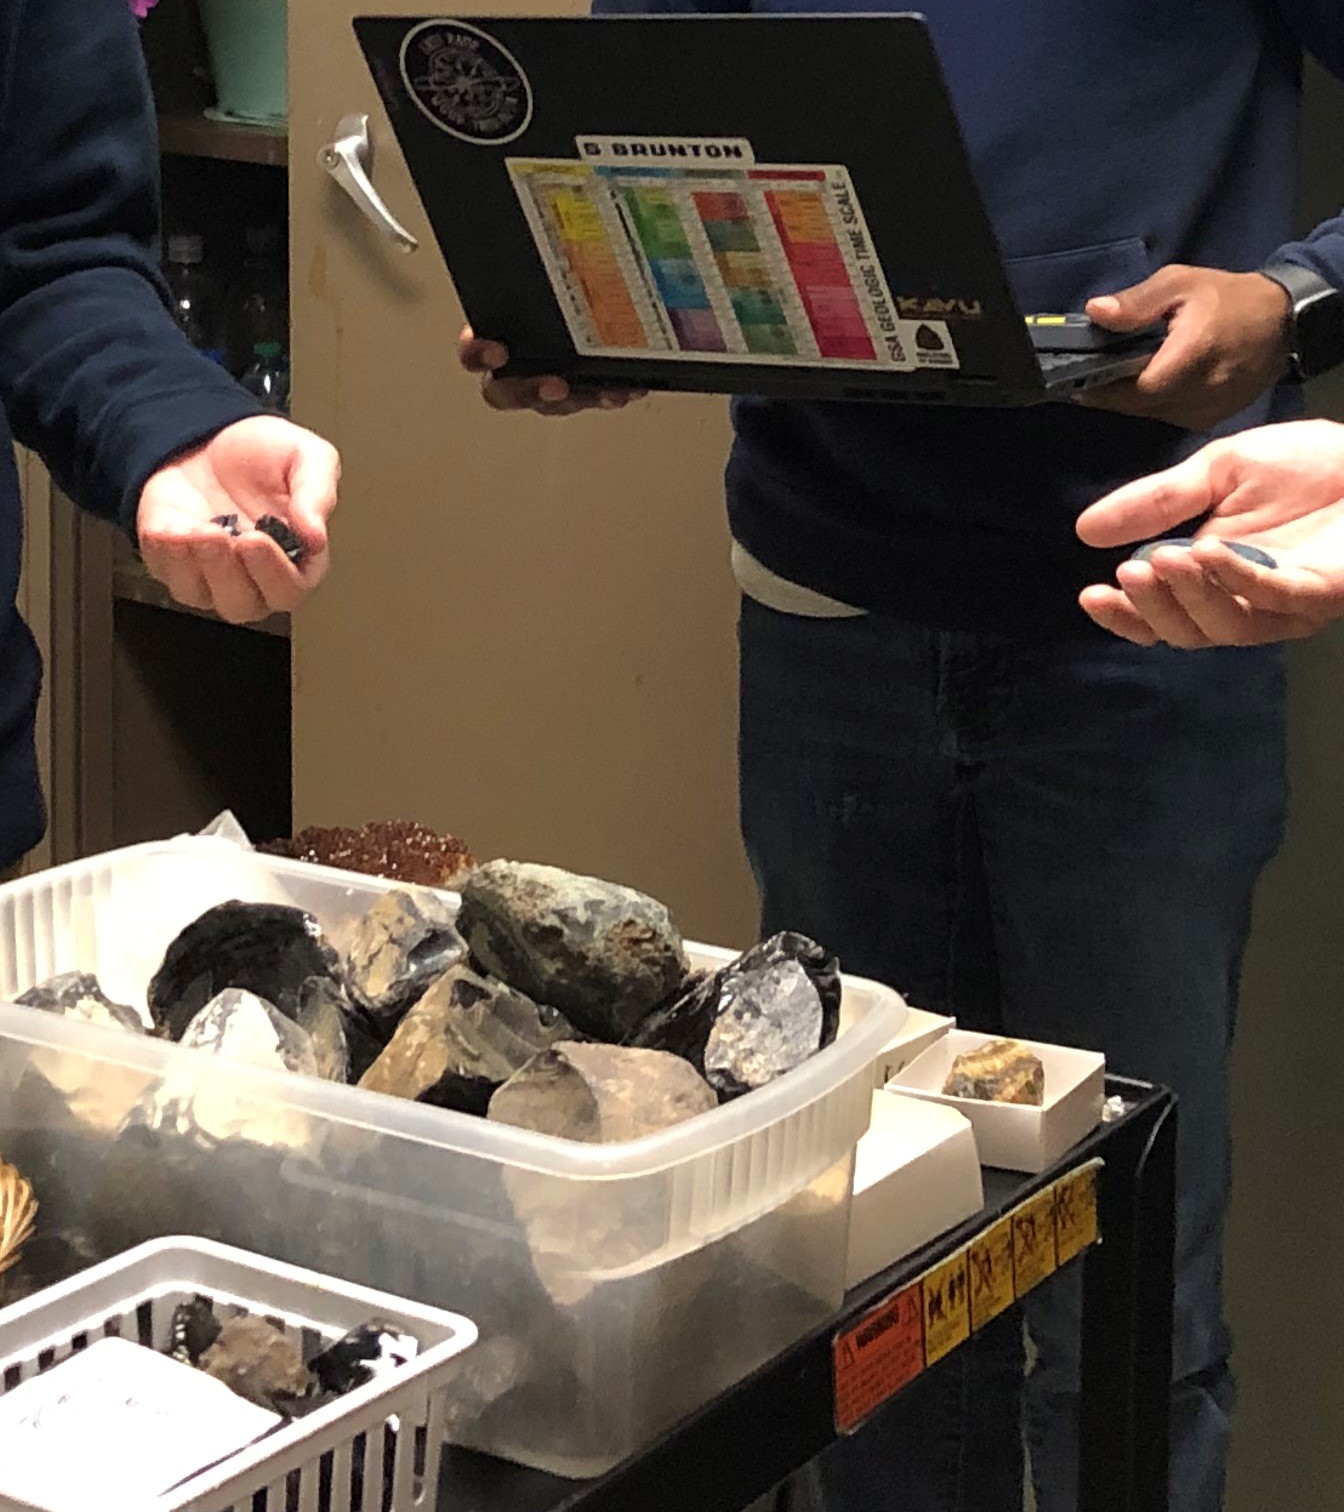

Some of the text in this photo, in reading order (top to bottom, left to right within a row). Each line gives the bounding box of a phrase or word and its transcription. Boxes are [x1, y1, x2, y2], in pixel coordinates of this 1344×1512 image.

[611, 142, 744, 159] BRUNTON
[831, 181, 859, 226] SCALE
[848, 229, 871, 262] TIME
[860, 264, 897, 334] GEOLOGIC
